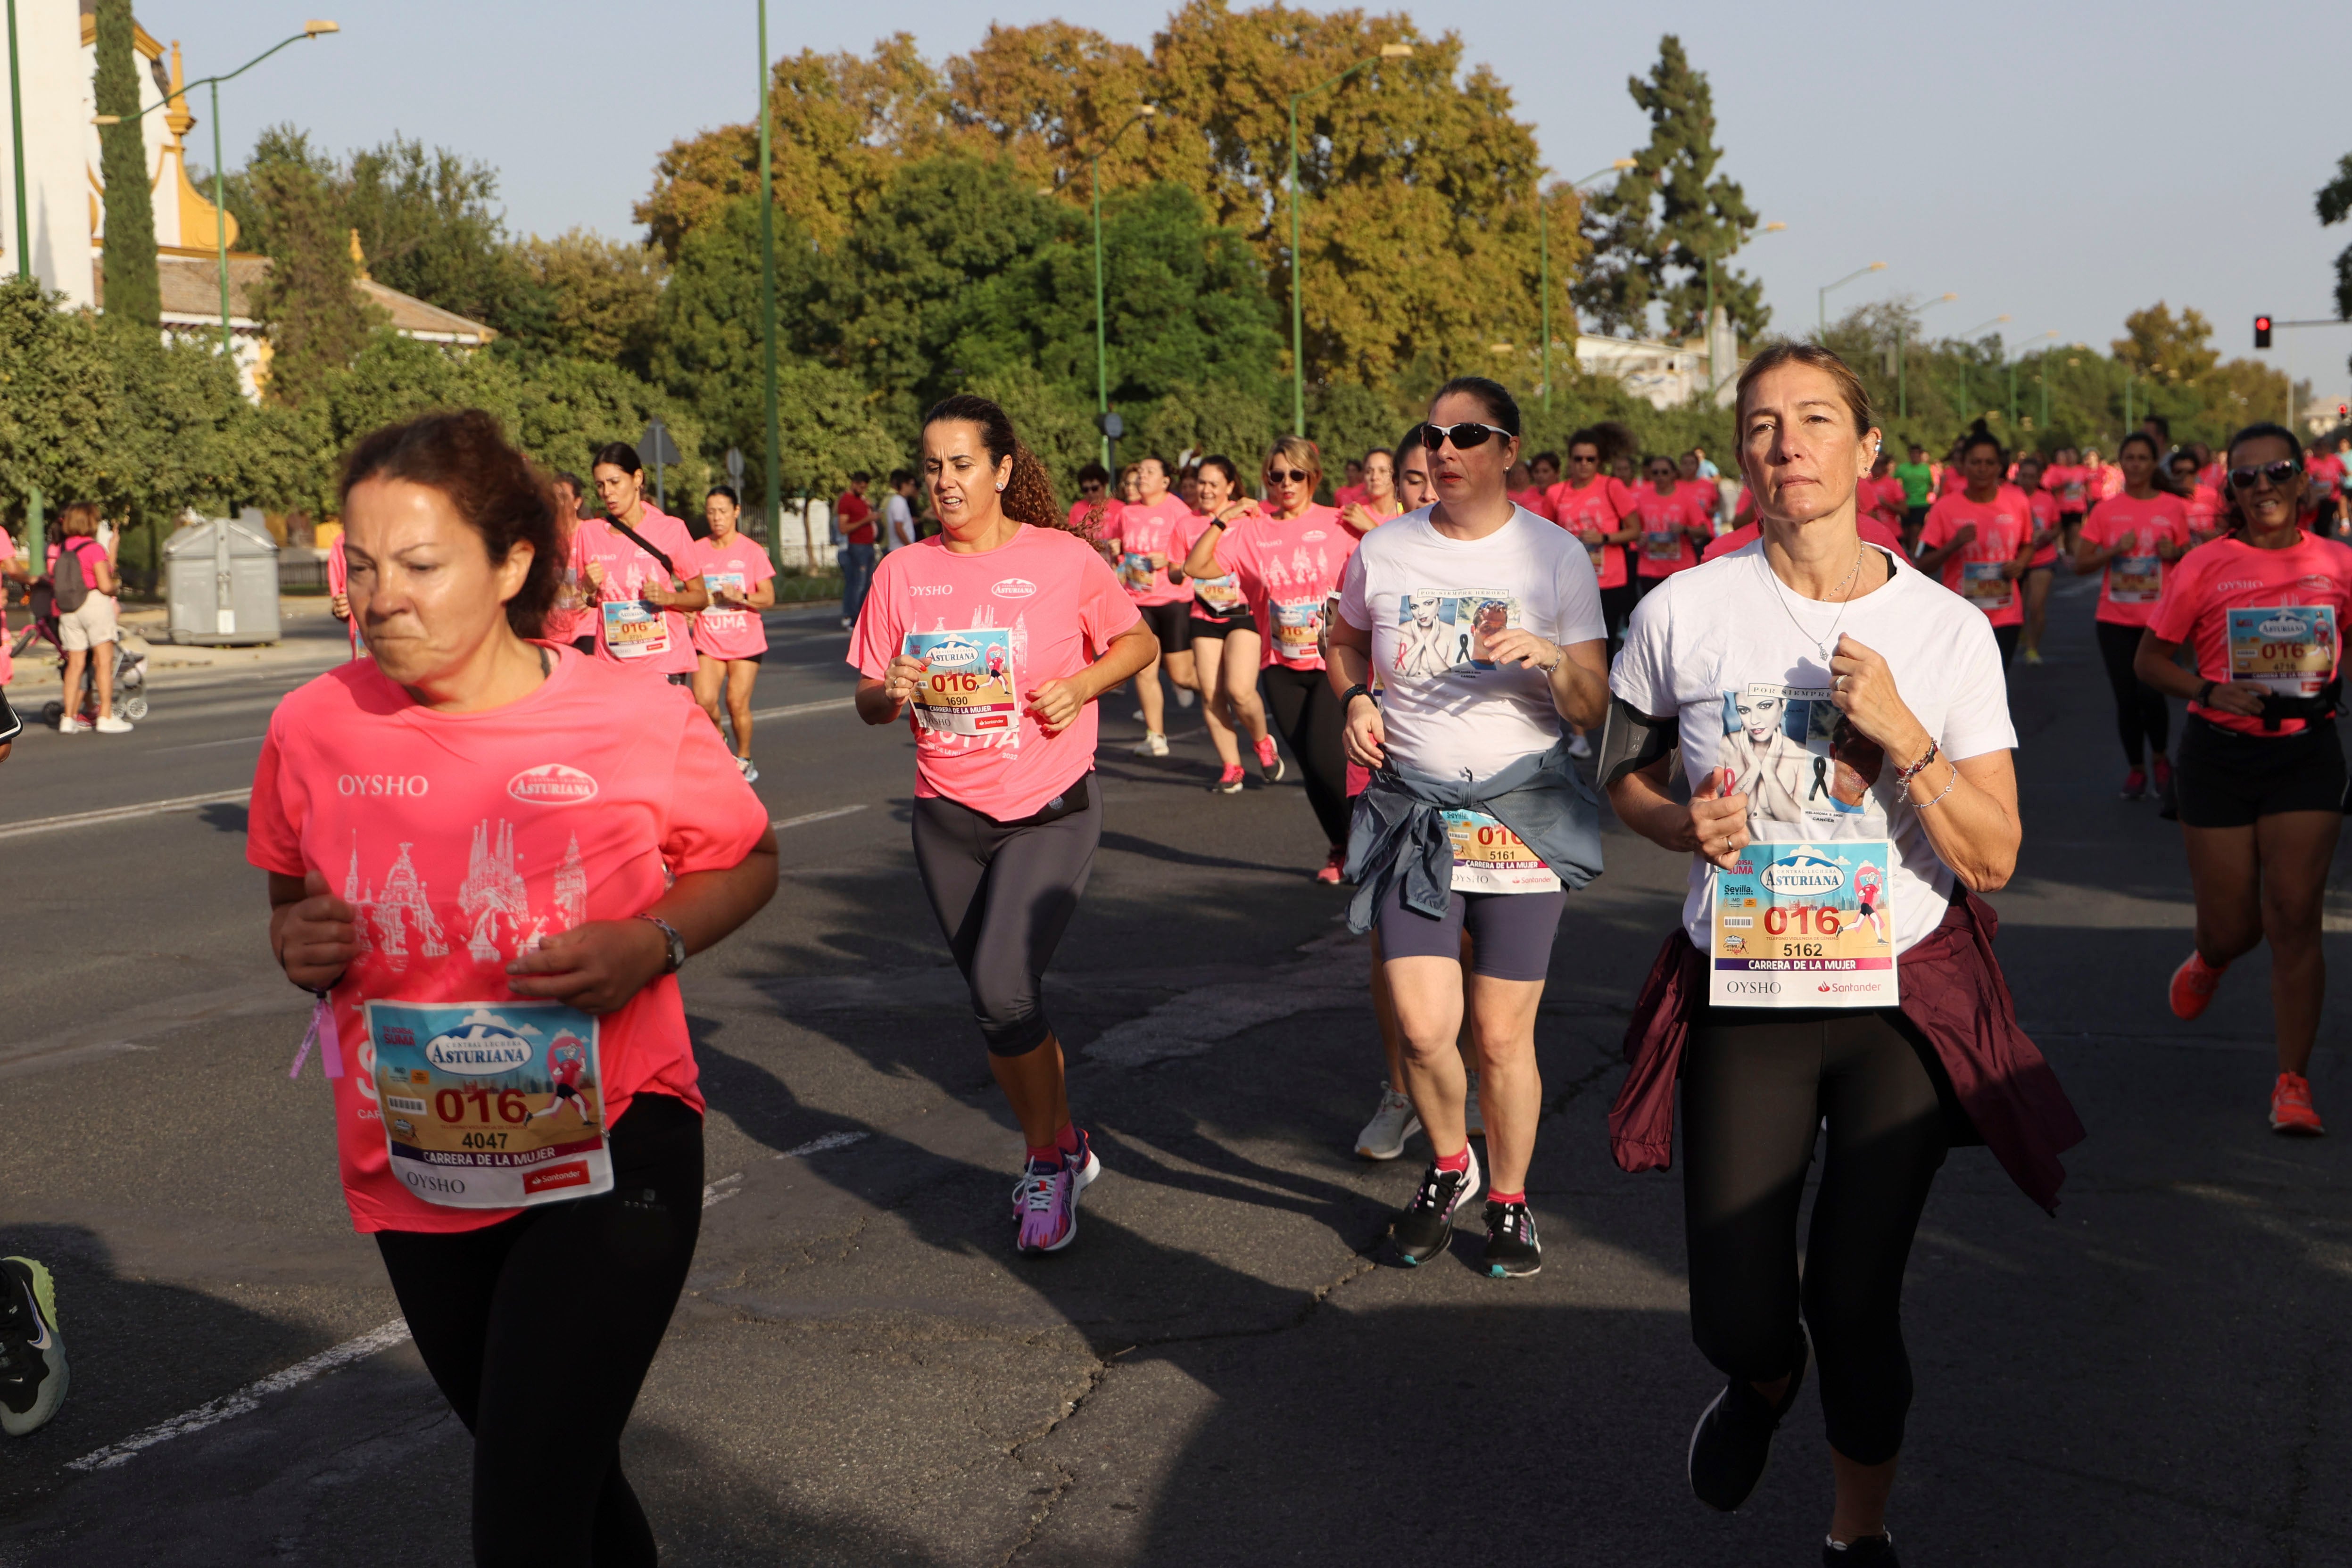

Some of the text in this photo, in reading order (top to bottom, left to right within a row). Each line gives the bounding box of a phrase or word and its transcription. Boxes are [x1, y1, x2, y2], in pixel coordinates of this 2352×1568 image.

[909, 584, 952, 596] OYSHO
[995, 586, 1033, 594] ASTURIANA
[621, 622, 647, 633] 016
[931, 652, 975, 661] ASTURIANA
[2262, 643, 2305, 659] 016
[931, 673, 977, 692] 016
[946, 696, 968, 705] 1690
[926, 716, 951, 726] OYSHO
[338, 775, 429, 796] OYSHO
[514, 779, 591, 795] ASTURIANA
[1490, 851, 1515, 860] 5161
[1466, 860, 1494, 868] CARRERA
[1452, 874, 1489, 883] OYSHO
[1765, 871, 1839, 886] ASTURIANA
[1764, 906, 1840, 935] 016
[1783, 943, 1822, 957] 5162
[1748, 959, 1856, 970] CARRERA DE LA MUJER
[1727, 981, 1881, 994] OYSHO Santander
[384, 1033, 416, 1046] SUMA
[432, 1044, 525, 1064] ASTURIANA
[436, 1088, 528, 1123] 016
[462, 1132, 508, 1149] 4047
[423, 1147, 556, 1165] CARRERA DE LA MUJER
[406, 1170, 581, 1194] OYSHO Santander
